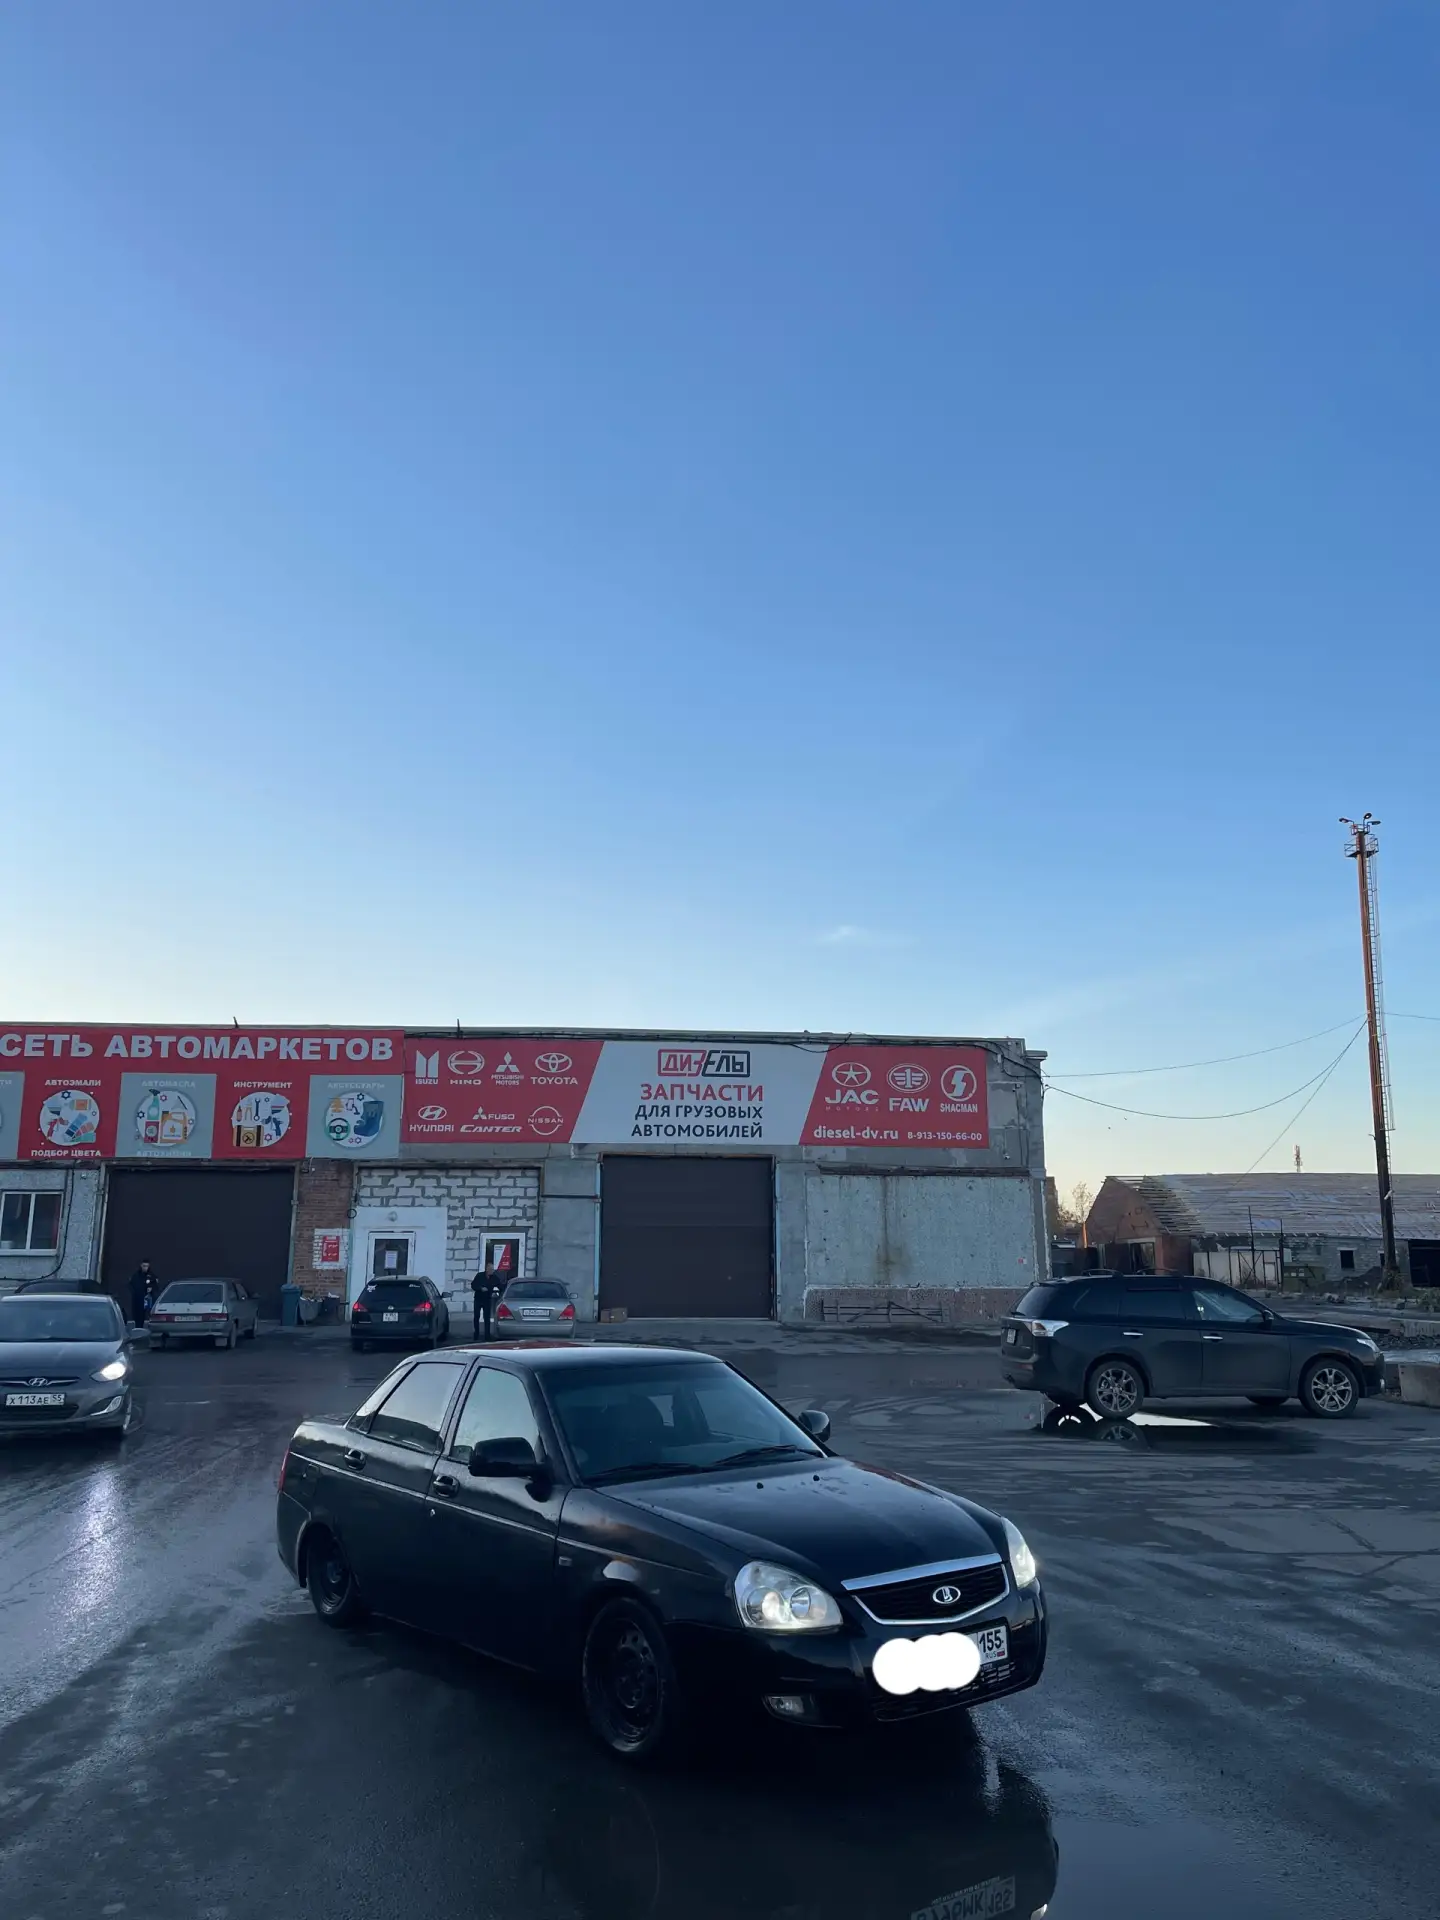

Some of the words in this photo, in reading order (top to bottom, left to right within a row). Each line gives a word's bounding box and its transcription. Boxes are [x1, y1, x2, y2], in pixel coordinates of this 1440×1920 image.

[0, 1033, 93, 1057] СЕТЬ
[104, 1035, 394, 1061] АВТОМАРКЕТОВ
[658, 1049, 750, 1077] ДИЗЕЛЬ
[45, 1079, 102, 1087] АВТОЭМАЛИ
[233, 1081, 293, 1089] ИНСТРУМЕНТ
[530, 1076, 578, 1085] TOYOTA
[640, 1083, 763, 1102] ЗАПЧАСТИ
[824, 1089, 880, 1105] JAC
[889, 1097, 930, 1112] FAW
[939, 1103, 978, 1113] SHACMAN
[635, 1105, 671, 1120] ДЛЯ
[675, 1105, 763, 1119] ГРУЗОВЫХ
[409, 1124, 454, 1132] HYUNDAI
[631, 1122, 763, 1138] АВТОМОБИЛЕЙ
[813, 1126, 899, 1140] diesel-dv.ru
[907, 1131, 983, 1141] 8-913-150-66-00
[31, 1149, 69, 1158] ПОДБОР
[71, 1150, 102, 1158] ЦВЕТА
[979, 1628, 1002, 1653] 155
[985, 1650, 997, 1659] RUS
